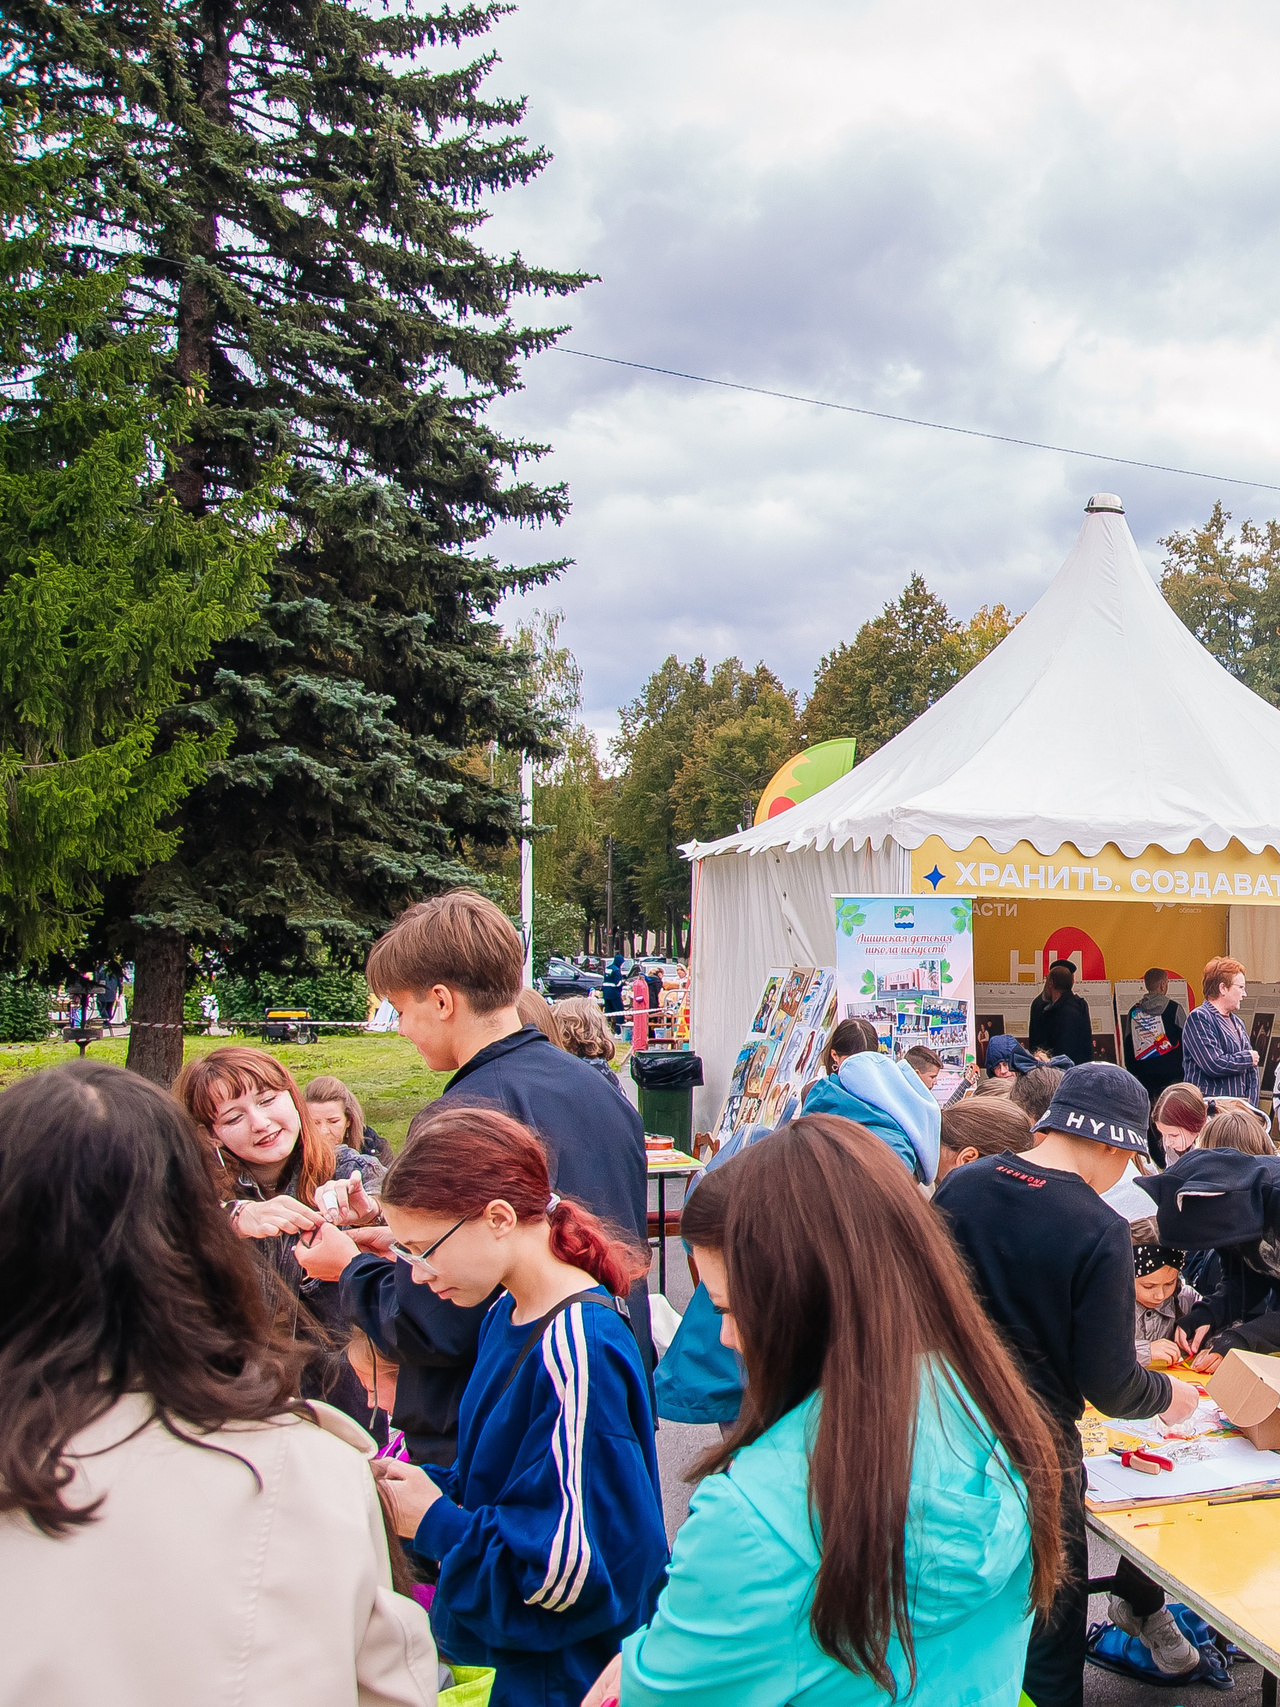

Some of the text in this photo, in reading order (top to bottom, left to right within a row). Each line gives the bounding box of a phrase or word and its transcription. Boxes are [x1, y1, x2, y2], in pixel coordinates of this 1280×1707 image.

[955, 861, 1122, 892] ХРАНИТЬ.
[972, 902, 1018, 917] АСТИ
[865, 946, 899, 955] школа
[995, 1165, 1047, 1185] RICHMOND
